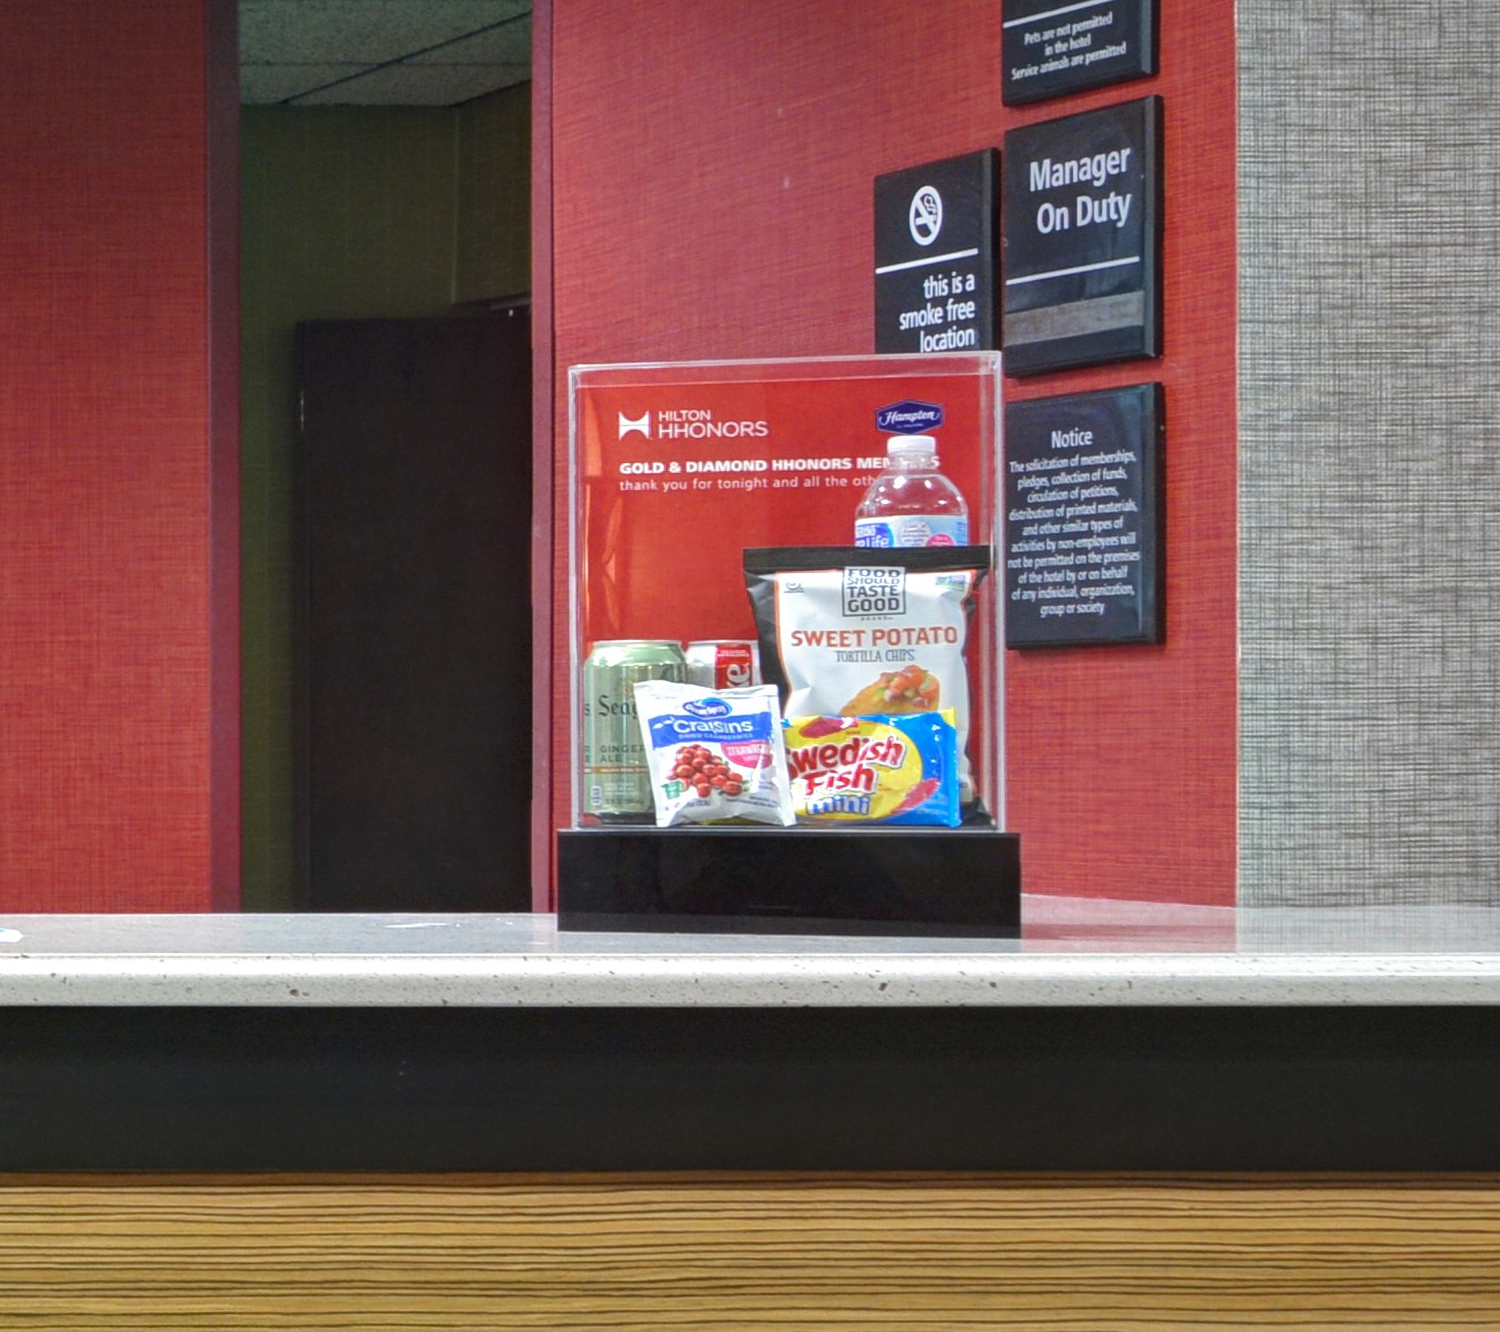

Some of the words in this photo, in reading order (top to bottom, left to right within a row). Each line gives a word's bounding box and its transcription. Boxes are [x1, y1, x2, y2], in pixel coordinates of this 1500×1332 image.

[1024, 31, 1041, 45] Pets
[1042, 28, 1055, 40] are
[1056, 23, 1071, 37] not
[1072, 10, 1113, 36] permitted
[1044, 43, 1054, 56] in
[1054, 40, 1069, 54] the
[1069, 33, 1092, 50] hotel
[1011, 64, 1039, 80] Service
[1040, 55, 1070, 74] animals
[1070, 54, 1084, 67] are
[1085, 40, 1127, 66] permitted
[1029, 147, 1132, 192] Manager
[1036, 202, 1069, 234] On
[1076, 191, 1132, 228] Duty
[923, 273, 949, 299] this
[951, 271, 963, 294] is
[964, 273, 975, 292] a
[899, 301, 943, 330] smoke
[946, 297, 975, 322] free
[919, 327, 975, 353] location
[658, 410, 711, 422] HILTON
[879, 410, 940, 426] Hampton
[658, 421, 769, 439] HHONORS
[1051, 427, 1093, 448] Notice
[619, 462, 665, 474] GOLD
[669, 461, 681, 473] &
[686, 460, 767, 473] DIAMOND
[772, 457, 852, 471] HHONORS
[1009, 461, 1024, 473] The
[1025, 457, 1069, 472] solicitation
[1069, 454, 1080, 467] of
[1081, 449, 1137, 466] memberships,
[619, 479, 657, 491] thank
[662, 480, 688, 493] you
[692, 478, 712, 490] for
[717, 477, 768, 492] tonight
[772, 476, 799, 488] and
[803, 475, 820, 487] all
[825, 474, 849, 487] the
[1017, 475, 1050, 490] pledges,
[1051, 470, 1090, 485] collection
[1091, 468, 1102, 481] of
[1102, 466, 1128, 480] funds,
[1027, 489, 1068, 503] circulation
[1069, 486, 1080, 499] of
[1009, 505, 1054, 521] distribution
[1055, 504, 1065, 518] of
[1066, 502, 1096, 519] printed
[1022, 524, 1038, 536] and
[1039, 522, 1061, 534] other
[1062, 518, 1089, 533] similar
[1090, 519, 1113, 534] types
[1113, 515, 1124, 529] of
[1011, 539, 1045, 553] activities
[1046, 537, 1056, 552] by
[1058, 536, 1119, 550] non-employees
[1120, 532, 1136, 545] will
[1008, 557, 1022, 569] not
[1023, 555, 1033, 567] be
[1034, 553, 1074, 569] permitted
[1075, 554, 1087, 564] on
[1088, 552, 1102, 564] the
[1103, 549, 1140, 565] premises
[847, 569, 900, 578] FOOD
[847, 577, 900, 585] SHOULD
[1018, 572, 1028, 584] of
[1029, 571, 1043, 584] the
[1043, 569, 1065, 582] hotel
[1066, 570, 1076, 584] by
[1077, 570, 1087, 581] or
[1088, 570, 1100, 580] on
[1101, 565, 1128, 579] behalf
[847, 585, 900, 598] TASTE
[1011, 588, 1021, 600] of
[1021, 590, 1036, 602] any
[1038, 586, 1079, 599] individual,
[1080, 583, 1135, 600] organization,
[847, 598, 900, 613] GOOD
[1040, 604, 1064, 618] group
[1065, 603, 1075, 614] or
[1076, 601, 1105, 615] society
[791, 630, 866, 647] SWEET
[872, 626, 958, 647] POTATO
[835, 650, 882, 663] TORTILLA
[885, 649, 915, 662] CHIPS
[673, 720, 753, 735] Craisins
[600, 755, 622, 763] ALE
[802, 764, 875, 797] Fish
[806, 794, 871, 816] mini
